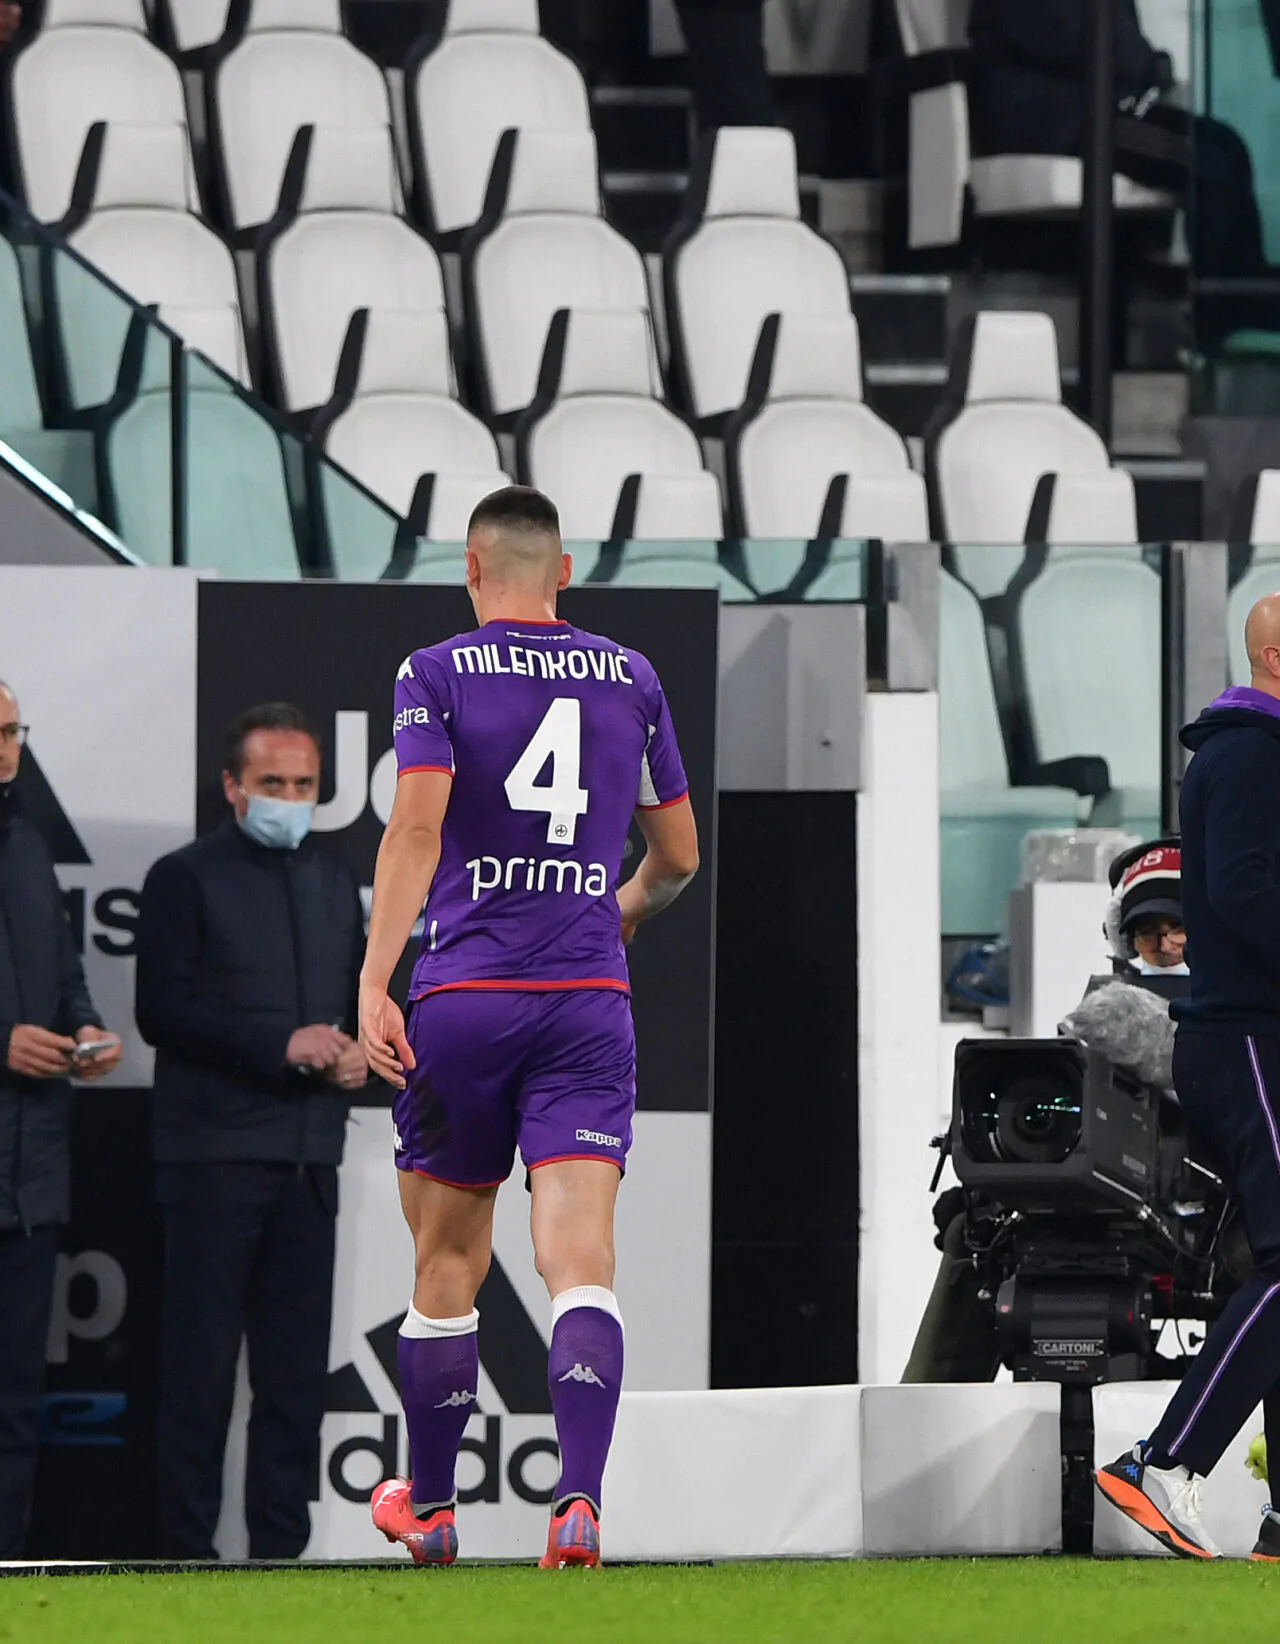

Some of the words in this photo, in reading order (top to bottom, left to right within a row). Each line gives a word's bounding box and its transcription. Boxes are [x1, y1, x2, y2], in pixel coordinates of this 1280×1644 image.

[452, 643, 633, 685] MILENKOVIĆ
[504, 697, 589, 846] 4
[466, 855, 607, 900] prima
[576, 1129, 622, 1148] Kappa
[1042, 1343, 1096, 1354] CARTONI
